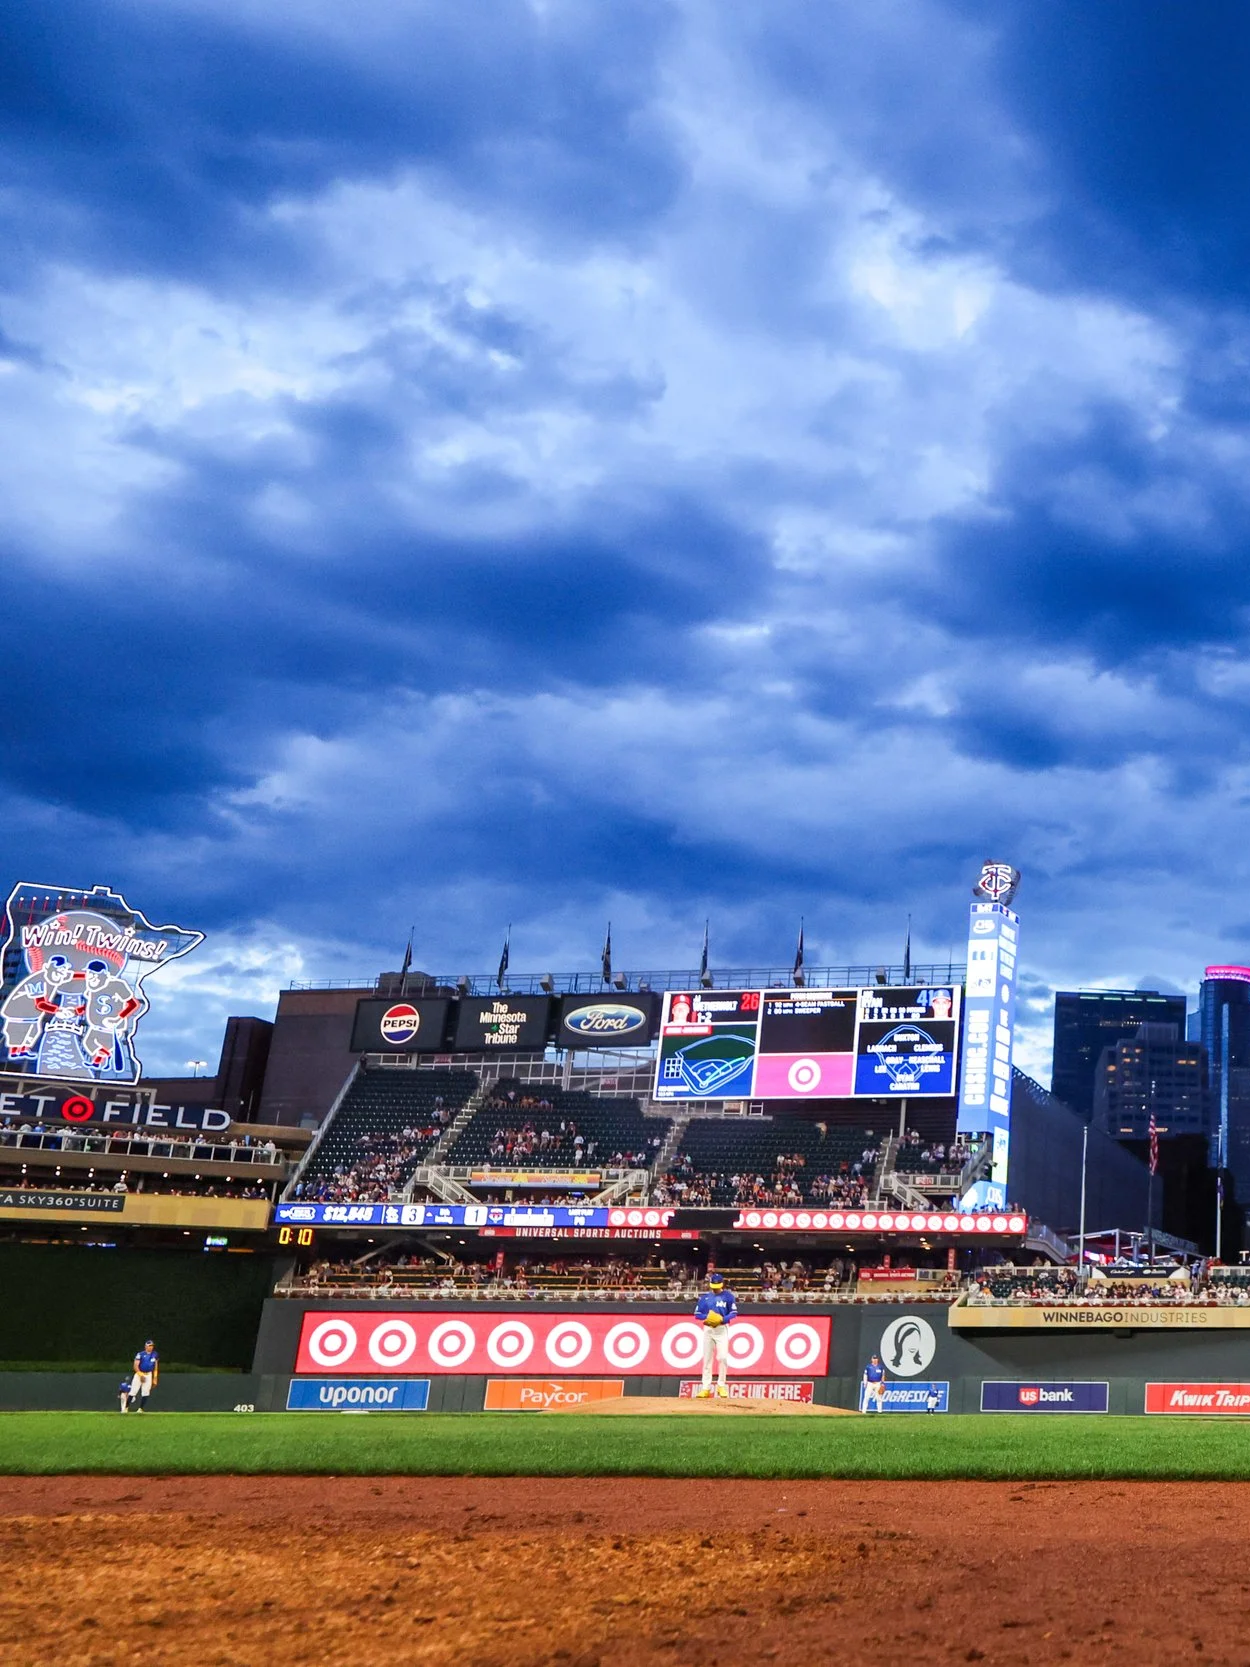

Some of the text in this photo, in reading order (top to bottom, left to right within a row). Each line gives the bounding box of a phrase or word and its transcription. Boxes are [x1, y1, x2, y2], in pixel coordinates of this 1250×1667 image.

[22, 922, 168, 960] Win! Twins!
[492, 1001, 508, 1013] The
[741, 993, 759, 1010] 26
[383, 1018, 417, 1029] PEPSI
[479, 1011, 526, 1023] Minnesota
[579, 1009, 628, 1032] Ford
[499, 1023, 520, 1035] Star
[484, 1033, 517, 1045] Tribune
[103, 1101, 232, 1131] FIELD
[408, 1208, 417, 1222] 3
[515, 1228, 662, 1239] UNIVERSAL SPORTS AUCTIONS
[1043, 1312, 1207, 1324] WINNEBAGO INDUSTRIES
[319, 1386, 399, 1407] uponor
[520, 1388, 588, 1405] Paycor
[768, 1384, 801, 1400] HERE
[233, 1404, 255, 1413] 403
